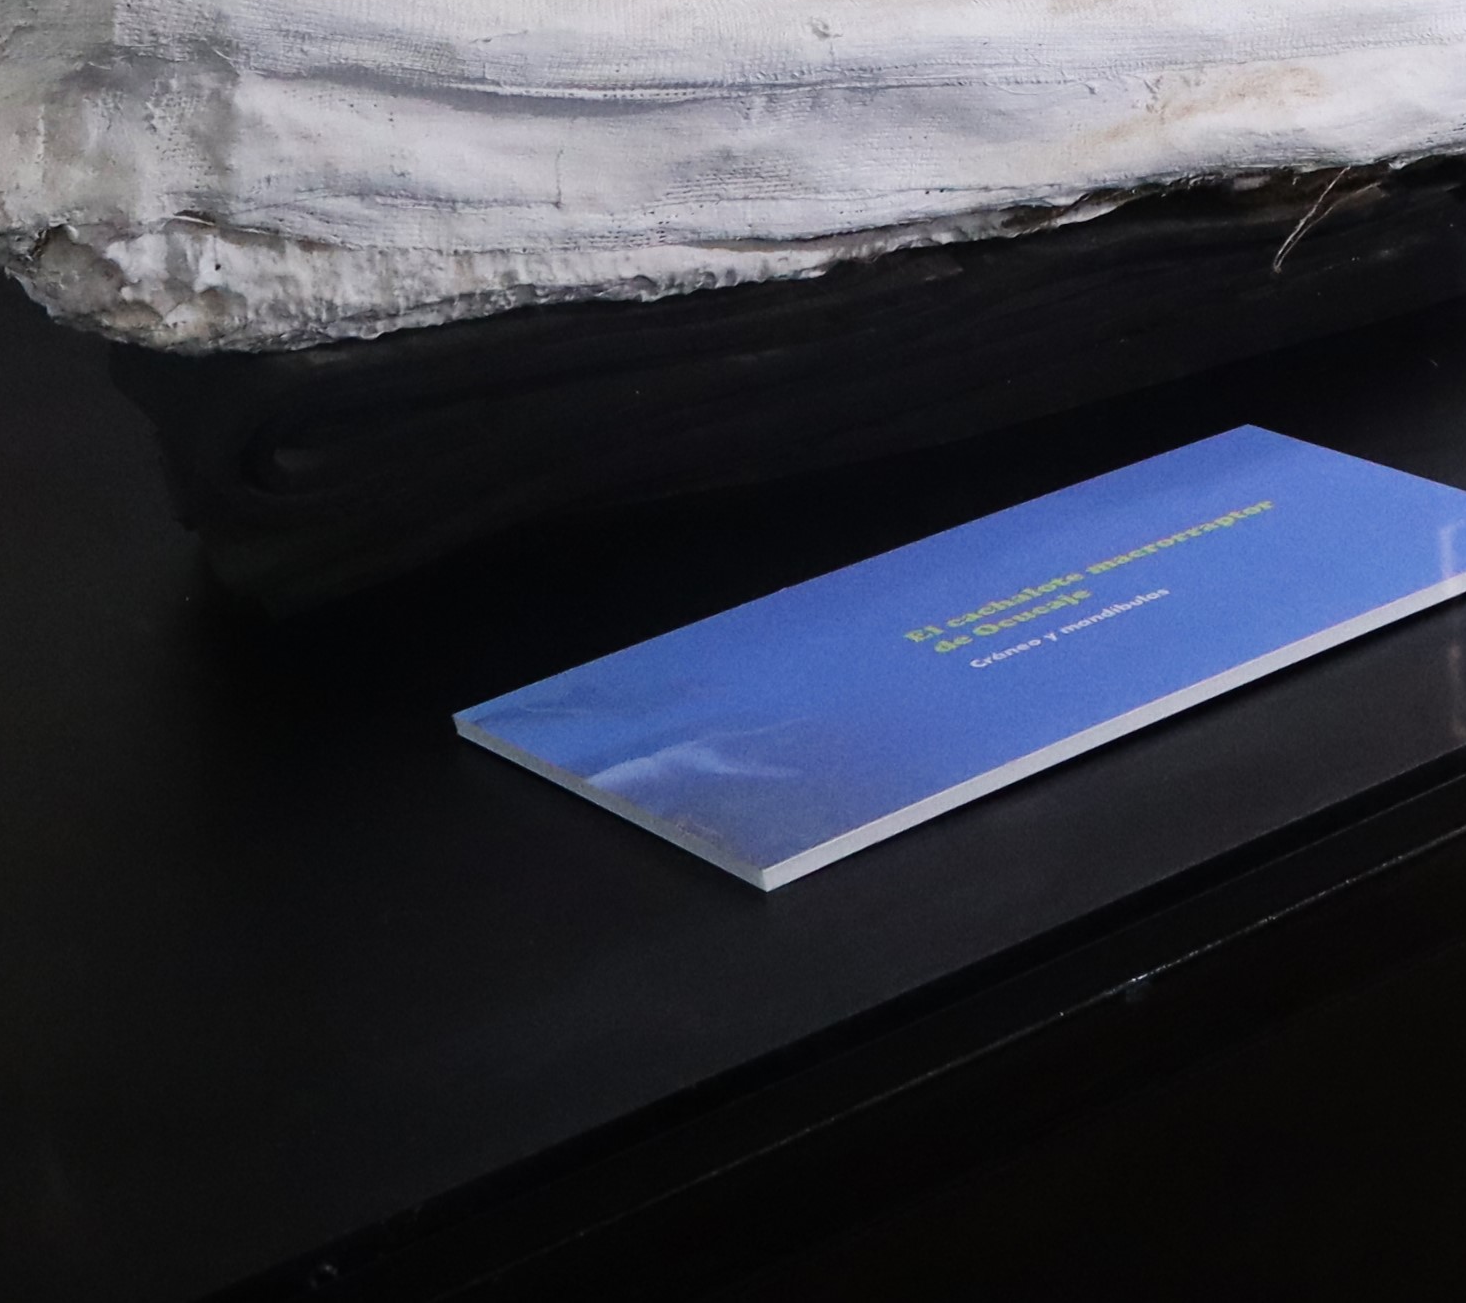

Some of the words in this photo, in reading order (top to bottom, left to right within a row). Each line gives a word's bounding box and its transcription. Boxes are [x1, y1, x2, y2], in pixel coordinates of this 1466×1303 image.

[904, 625, 943, 643] El
[946, 572, 1084, 628] cachalote
[1086, 499, 1274, 575] macrorraptor
[935, 634, 972, 653] de
[972, 589, 1092, 637] Ocucaje
[970, 637, 1041, 669] Cráneo
[1044, 631, 1058, 643] y
[1060, 588, 1170, 636] mandíbulas
